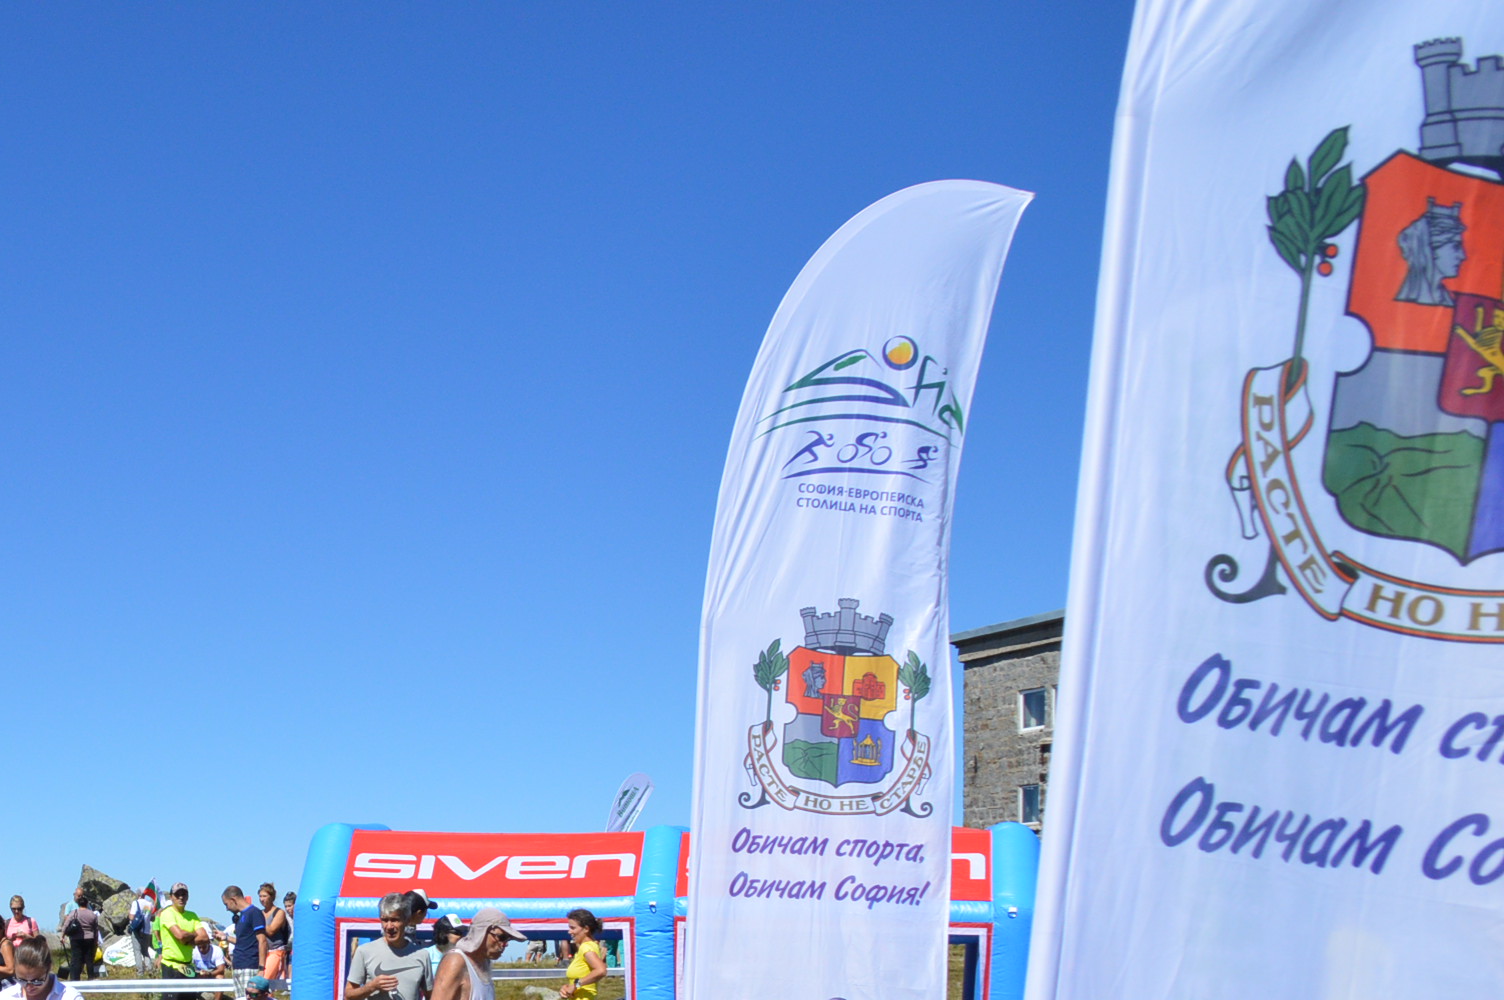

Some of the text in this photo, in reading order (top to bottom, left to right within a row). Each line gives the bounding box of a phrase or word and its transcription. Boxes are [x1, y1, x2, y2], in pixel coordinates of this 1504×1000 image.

[796, 497, 923, 522] СТОЛИЦА НА СПОРТА
[1253, 393, 1327, 595] РАСТЕ
[1365, 583, 1445, 627] НО
[1176, 652, 1425, 754] Обичам
[751, 733, 786, 802] РАСТЕ
[803, 796, 832, 810] НО
[839, 800, 869, 811] НЕ
[731, 826, 925, 866] Обичам спорта,
[1159, 776, 1403, 875] Обичам
[729, 871, 931, 910] Обичам София!
